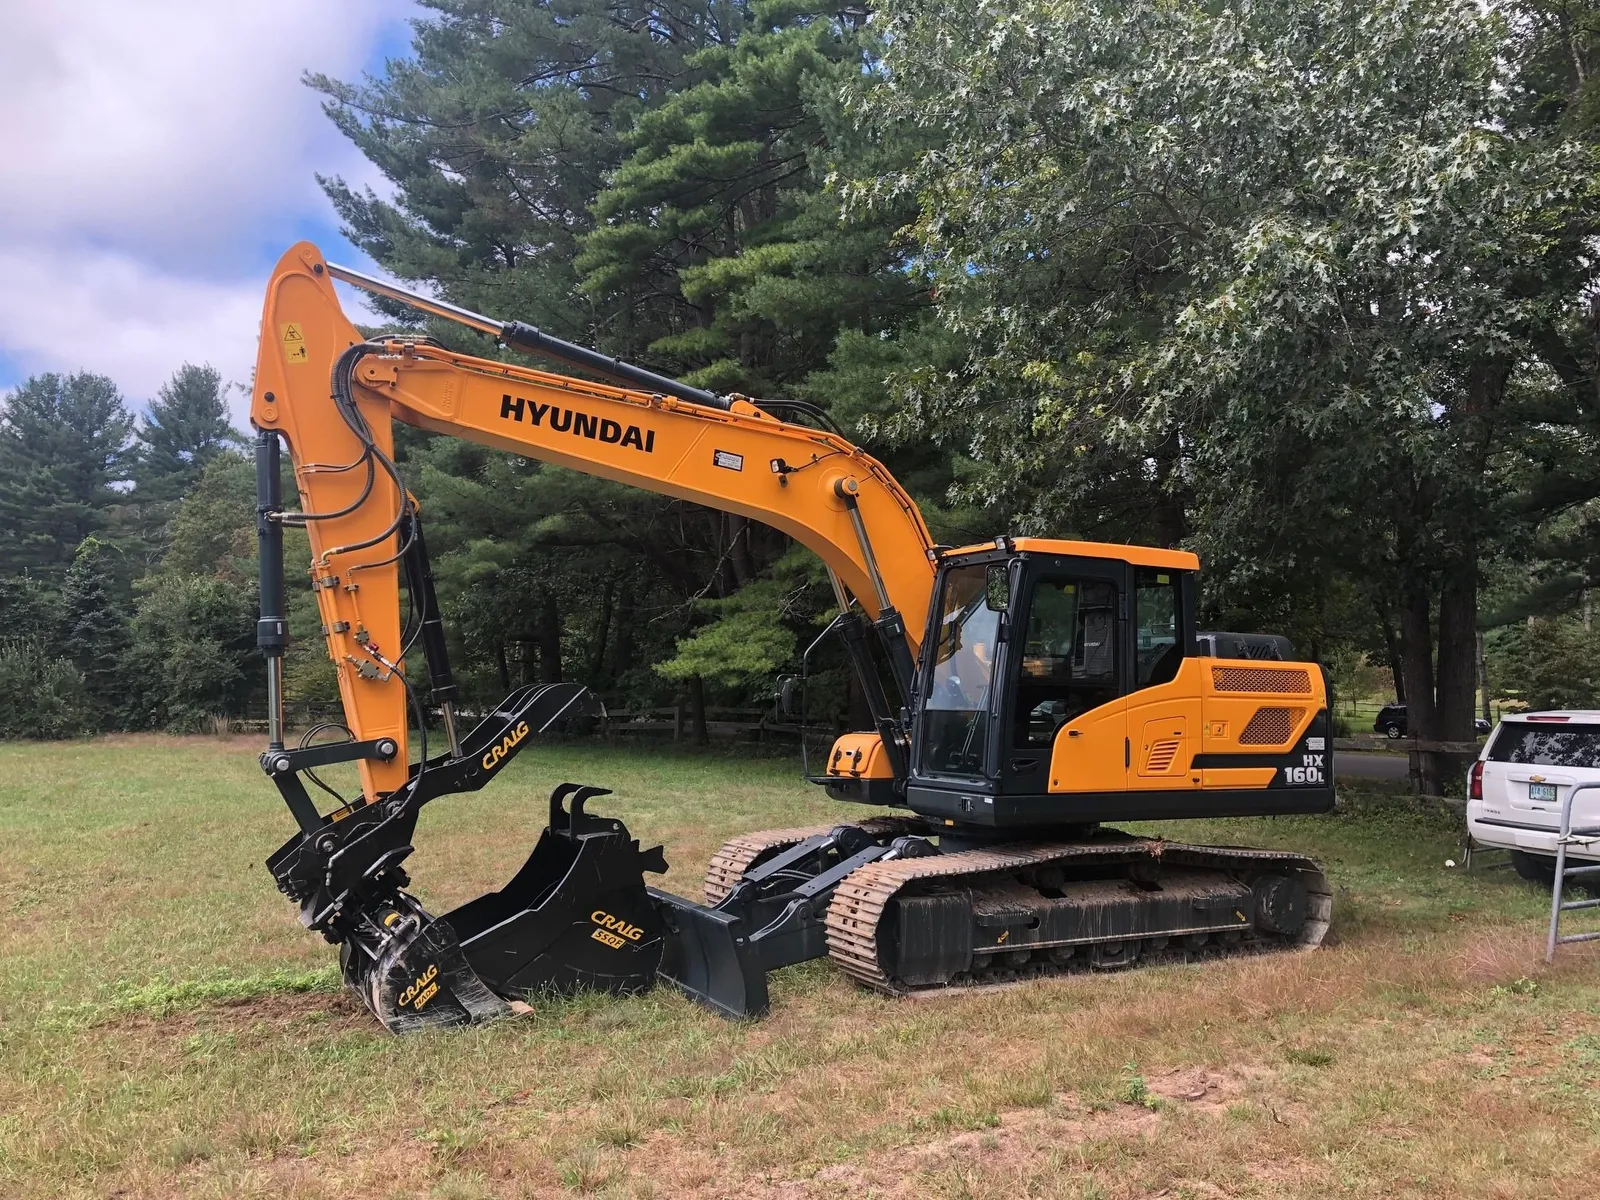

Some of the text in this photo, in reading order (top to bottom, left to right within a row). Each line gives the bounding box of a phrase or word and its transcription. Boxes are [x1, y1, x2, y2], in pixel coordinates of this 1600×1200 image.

[499, 394, 655, 453] HYUNDAI
[482, 720, 530, 770] CRAIG
[1303, 754, 1324, 766] HX
[1284, 766, 1325, 783] 160L
[590, 910, 645, 941] CRAIG
[398, 964, 438, 1006] CRAIG
